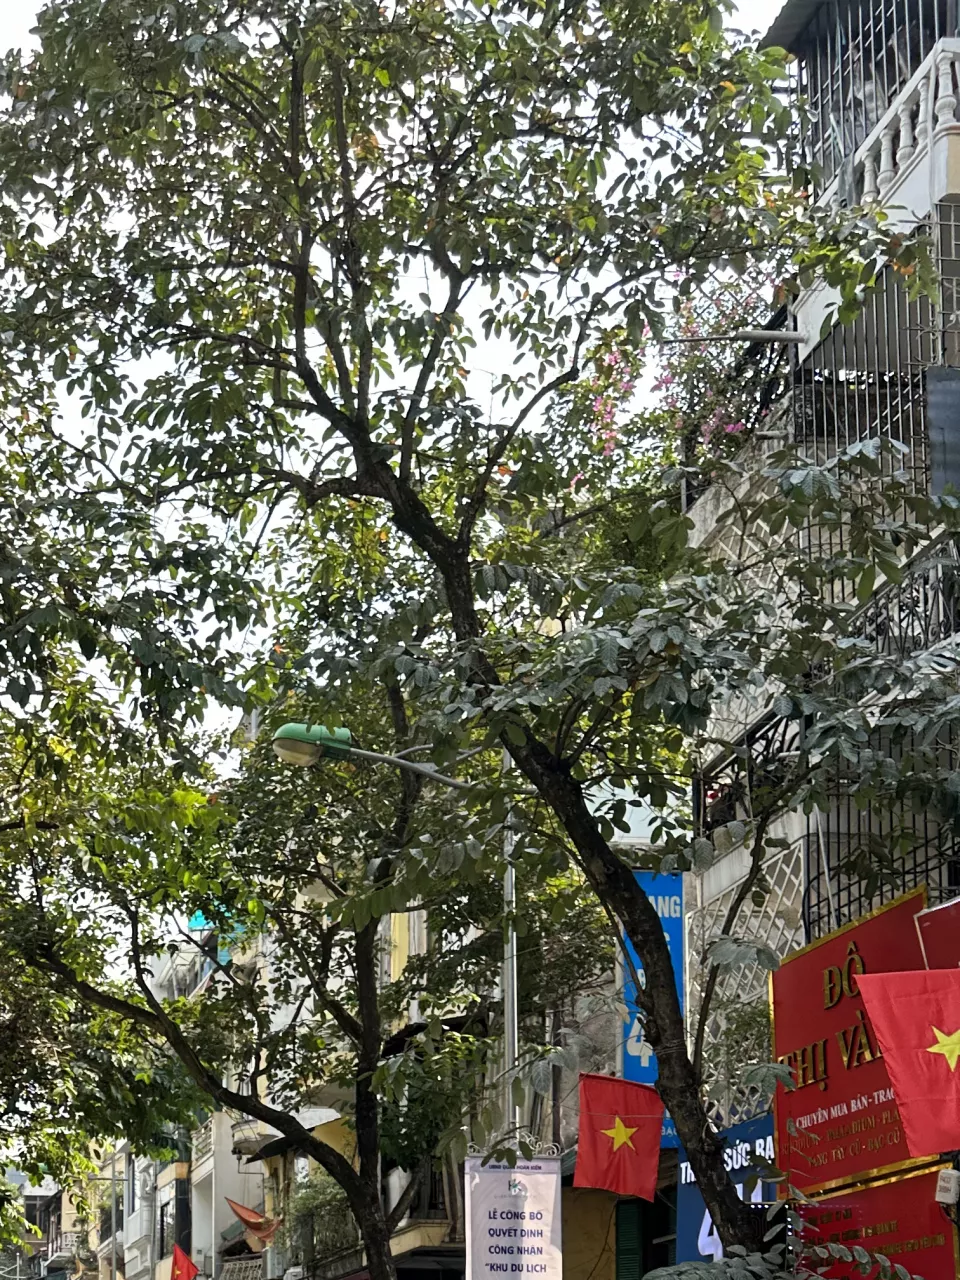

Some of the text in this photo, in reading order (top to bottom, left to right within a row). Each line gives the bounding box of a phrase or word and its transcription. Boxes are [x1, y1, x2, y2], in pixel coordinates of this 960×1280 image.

[836, 1009, 883, 1071] VÀ
[830, 1102, 848, 1119] MUA
[500, 1209, 526, 1221] CÔNG
[488, 1225, 518, 1238] QUYẾT
[488, 1243, 514, 1255] CÔNG
[510, 1264, 524, 1272] DU
[526, 1264, 547, 1273] LỊCH
